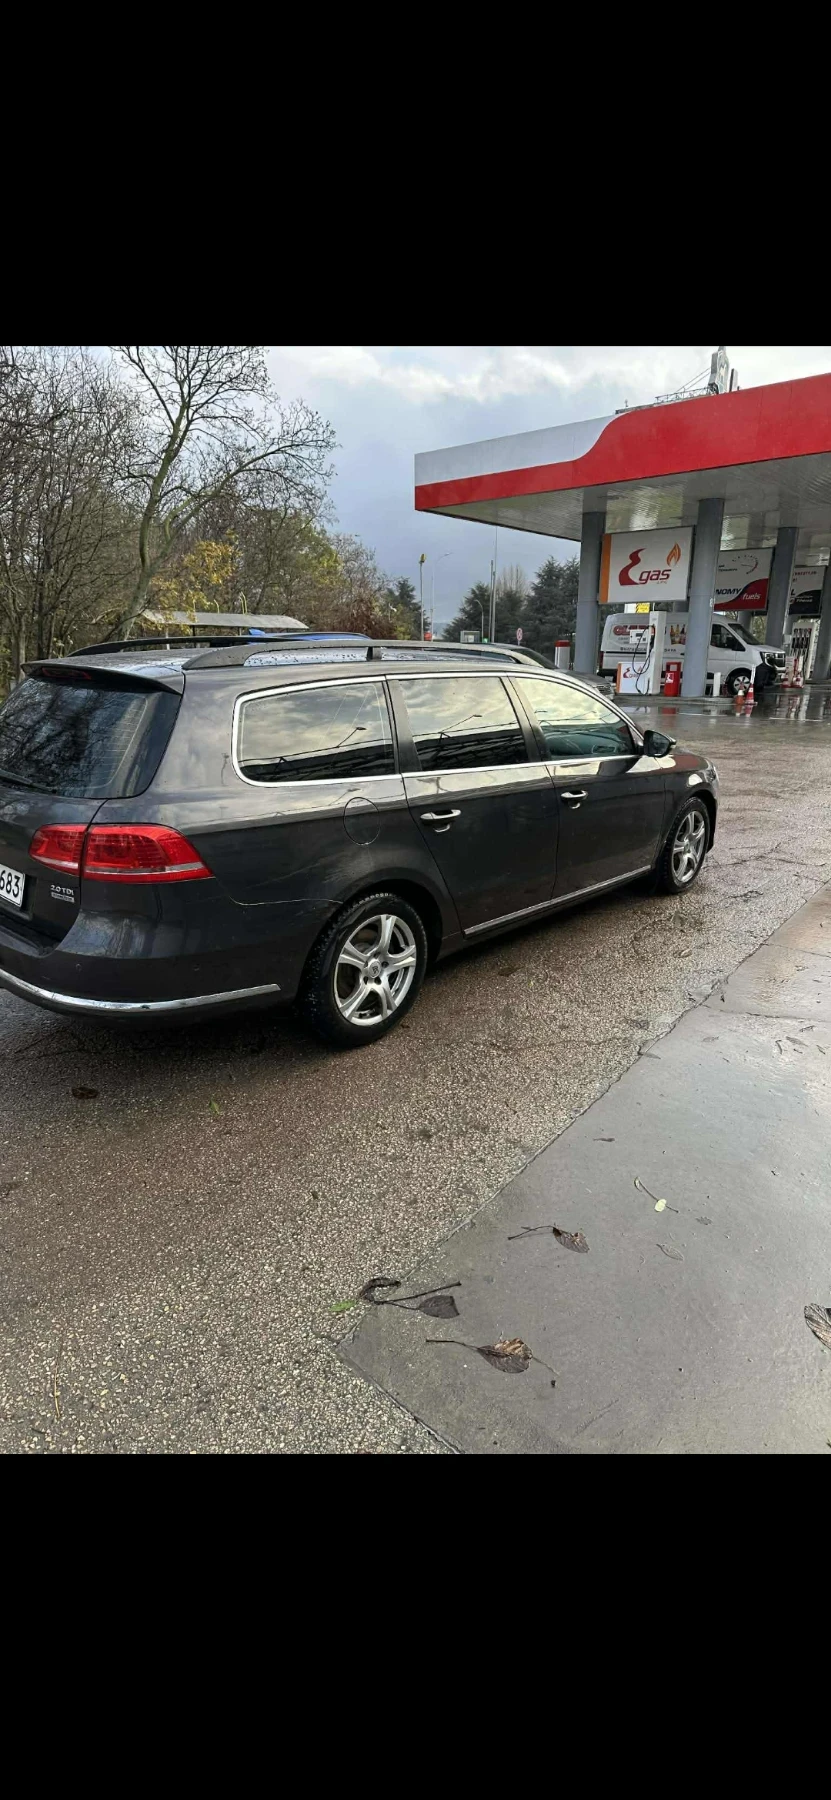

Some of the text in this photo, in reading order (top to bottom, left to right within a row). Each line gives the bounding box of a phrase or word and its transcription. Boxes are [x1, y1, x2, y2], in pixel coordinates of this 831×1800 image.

[743, 592, 761, 600] fuels
[0, 870, 20, 898] 683
[61, 887, 74, 896] TDI
